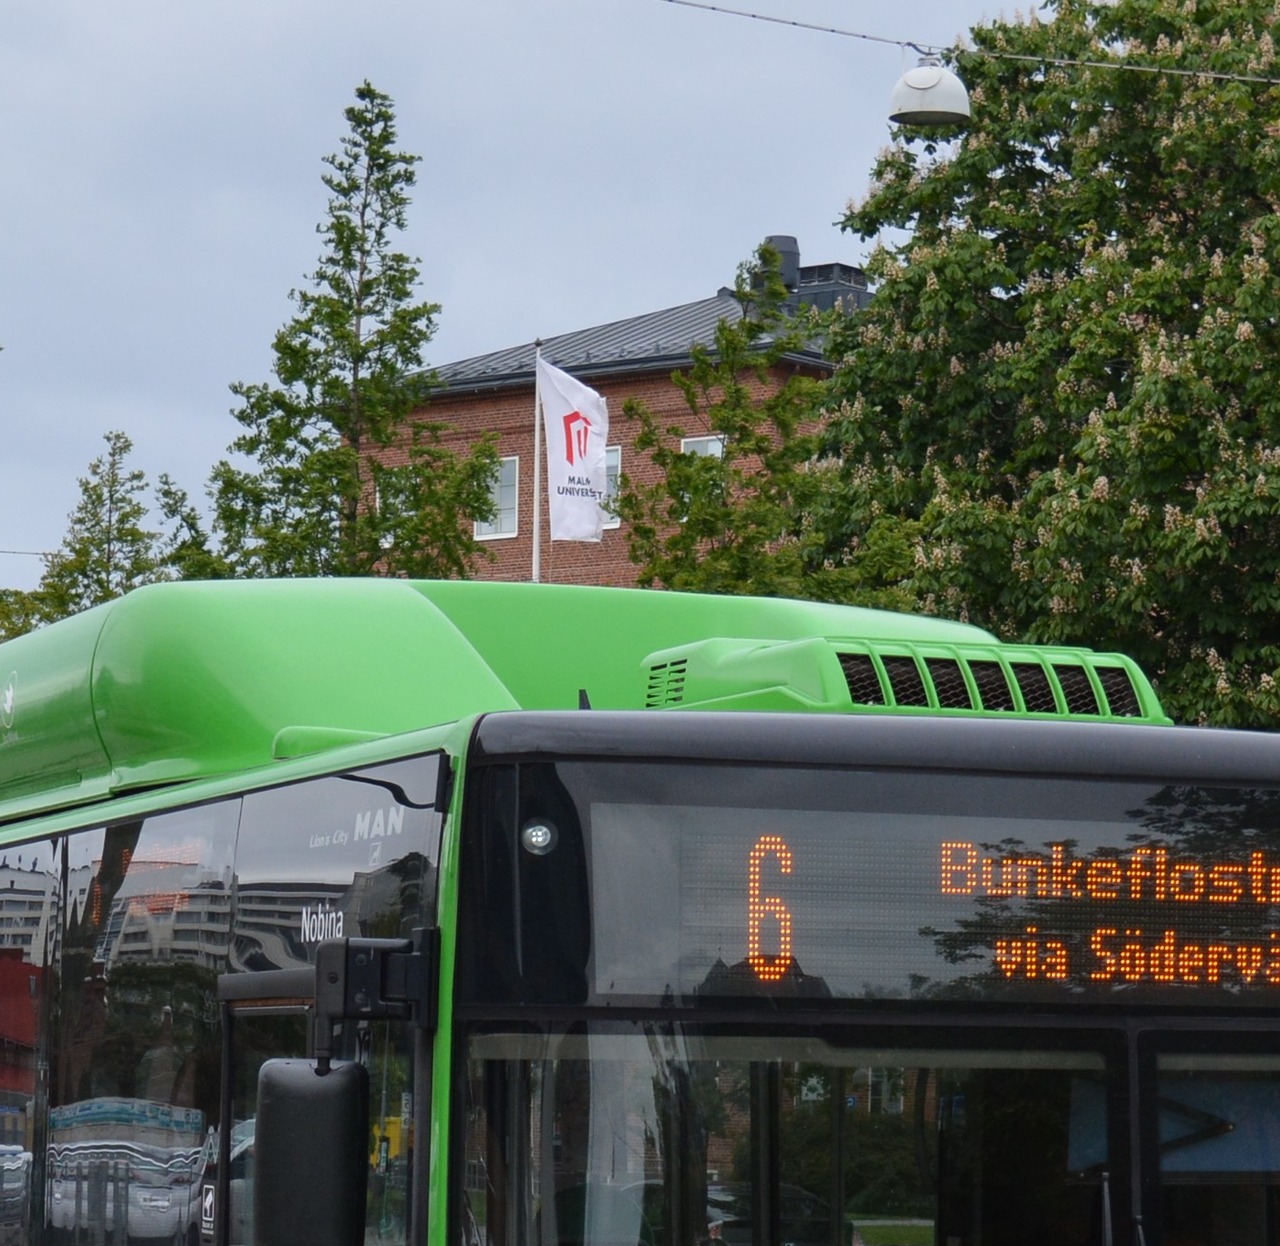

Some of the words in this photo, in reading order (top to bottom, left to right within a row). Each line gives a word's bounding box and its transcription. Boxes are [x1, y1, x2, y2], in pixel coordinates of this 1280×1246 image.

[332, 829, 350, 847] City
[353, 806, 405, 841] MAN
[300, 903, 344, 942] Nobina
[747, 834, 794, 982] 6
[992, 925, 1069, 981] via
